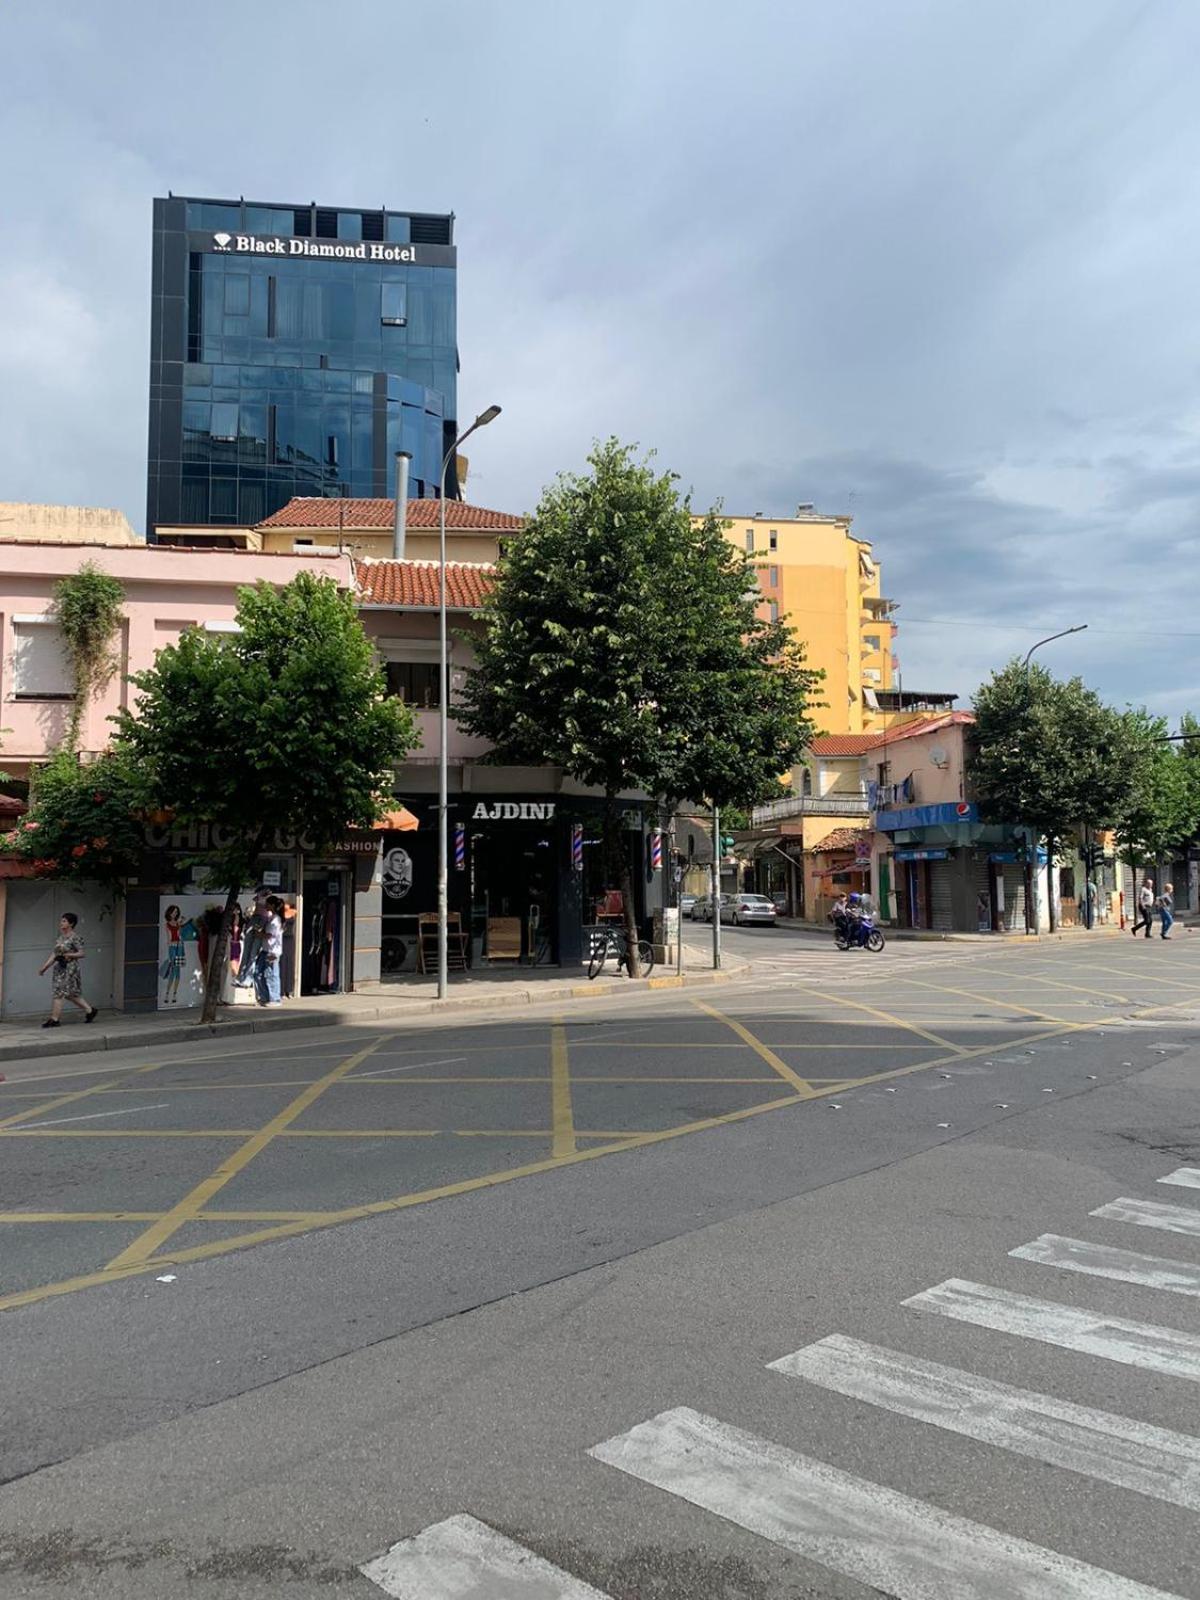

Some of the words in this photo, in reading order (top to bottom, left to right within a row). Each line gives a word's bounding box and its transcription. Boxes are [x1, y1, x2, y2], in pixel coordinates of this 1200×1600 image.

[236, 236, 286, 254] Black
[289, 239, 366, 259] Diamond
[370, 244, 416, 262] Hotel
[472, 802, 556, 819] AJDINI
